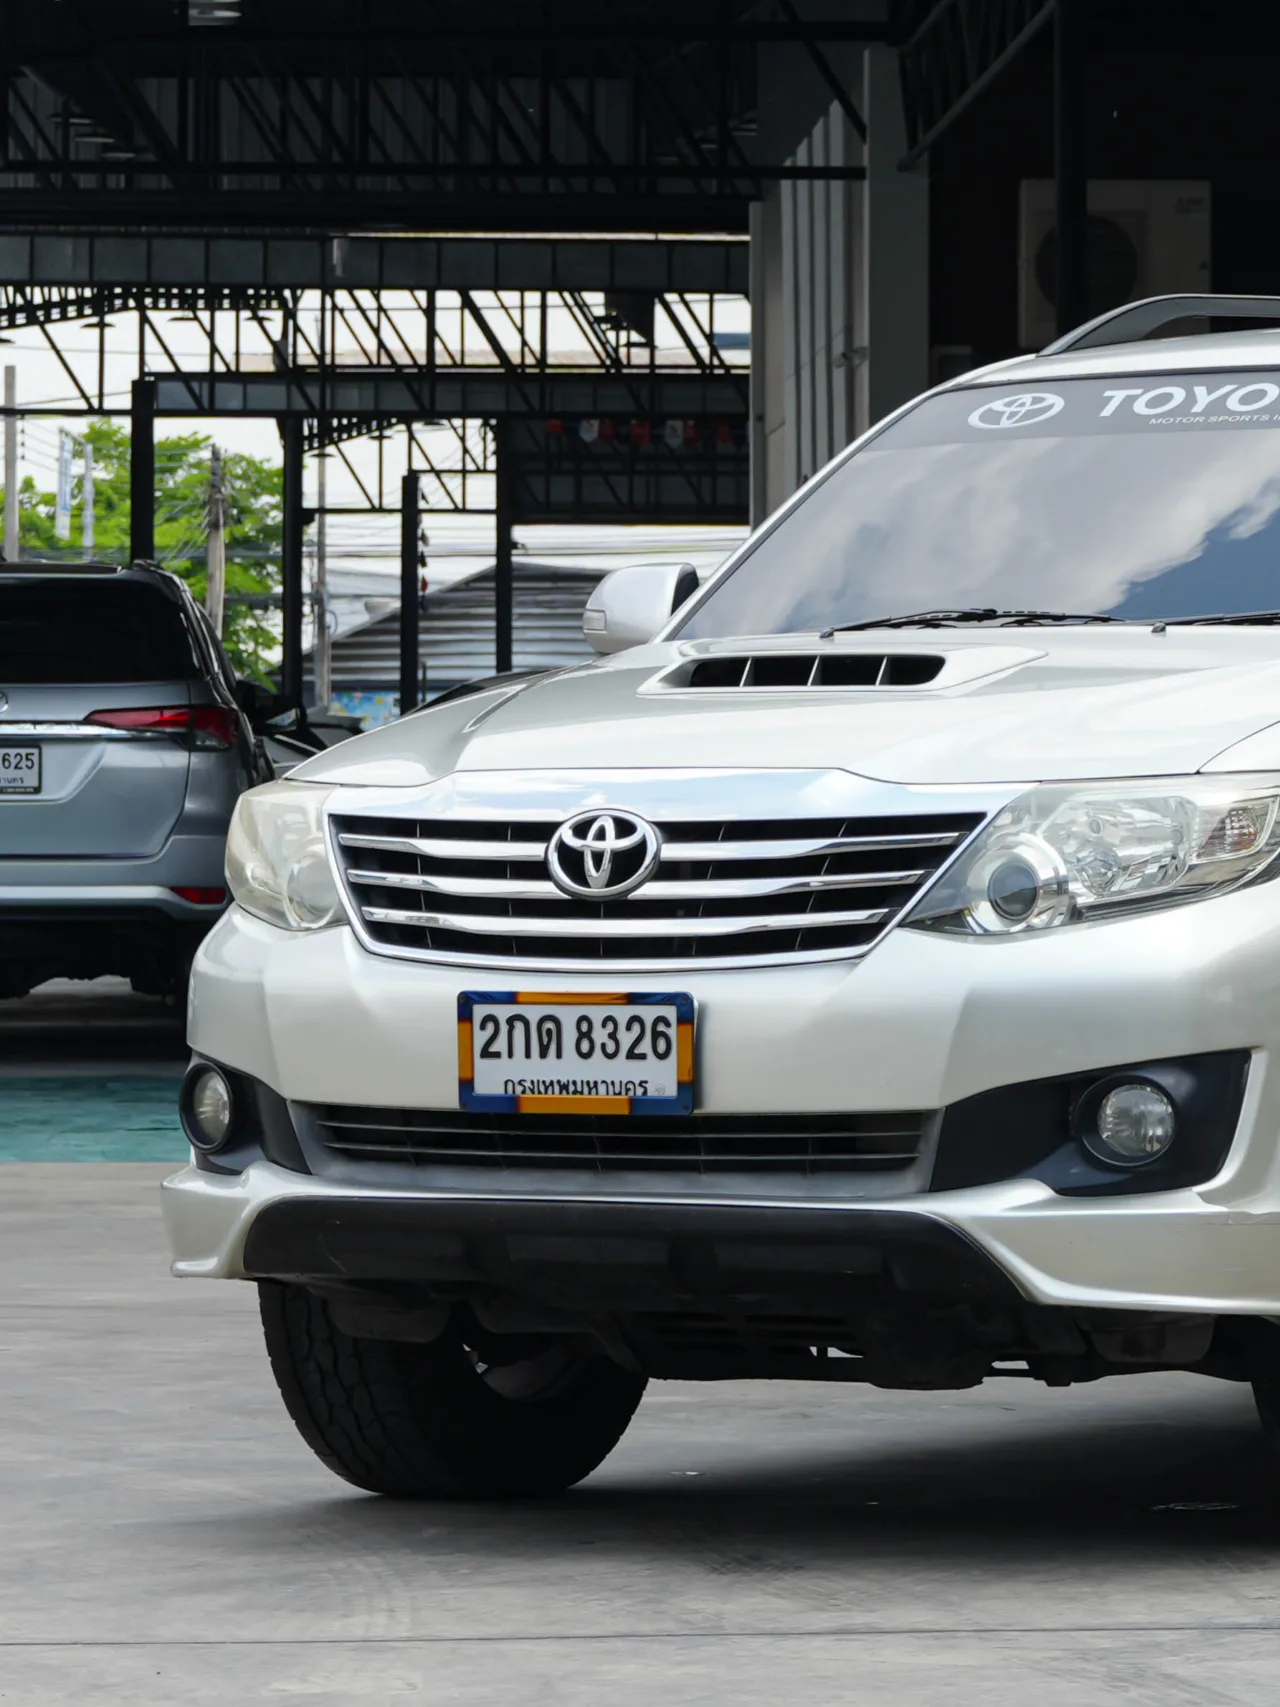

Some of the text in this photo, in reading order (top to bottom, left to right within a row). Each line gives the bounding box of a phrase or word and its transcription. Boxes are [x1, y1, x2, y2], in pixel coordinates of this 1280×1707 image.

[1148, 416, 1206, 426] MOTOR
[1208, 414, 1271, 424] SPORTS
[479, 1013, 673, 1061] 2กด 8326
